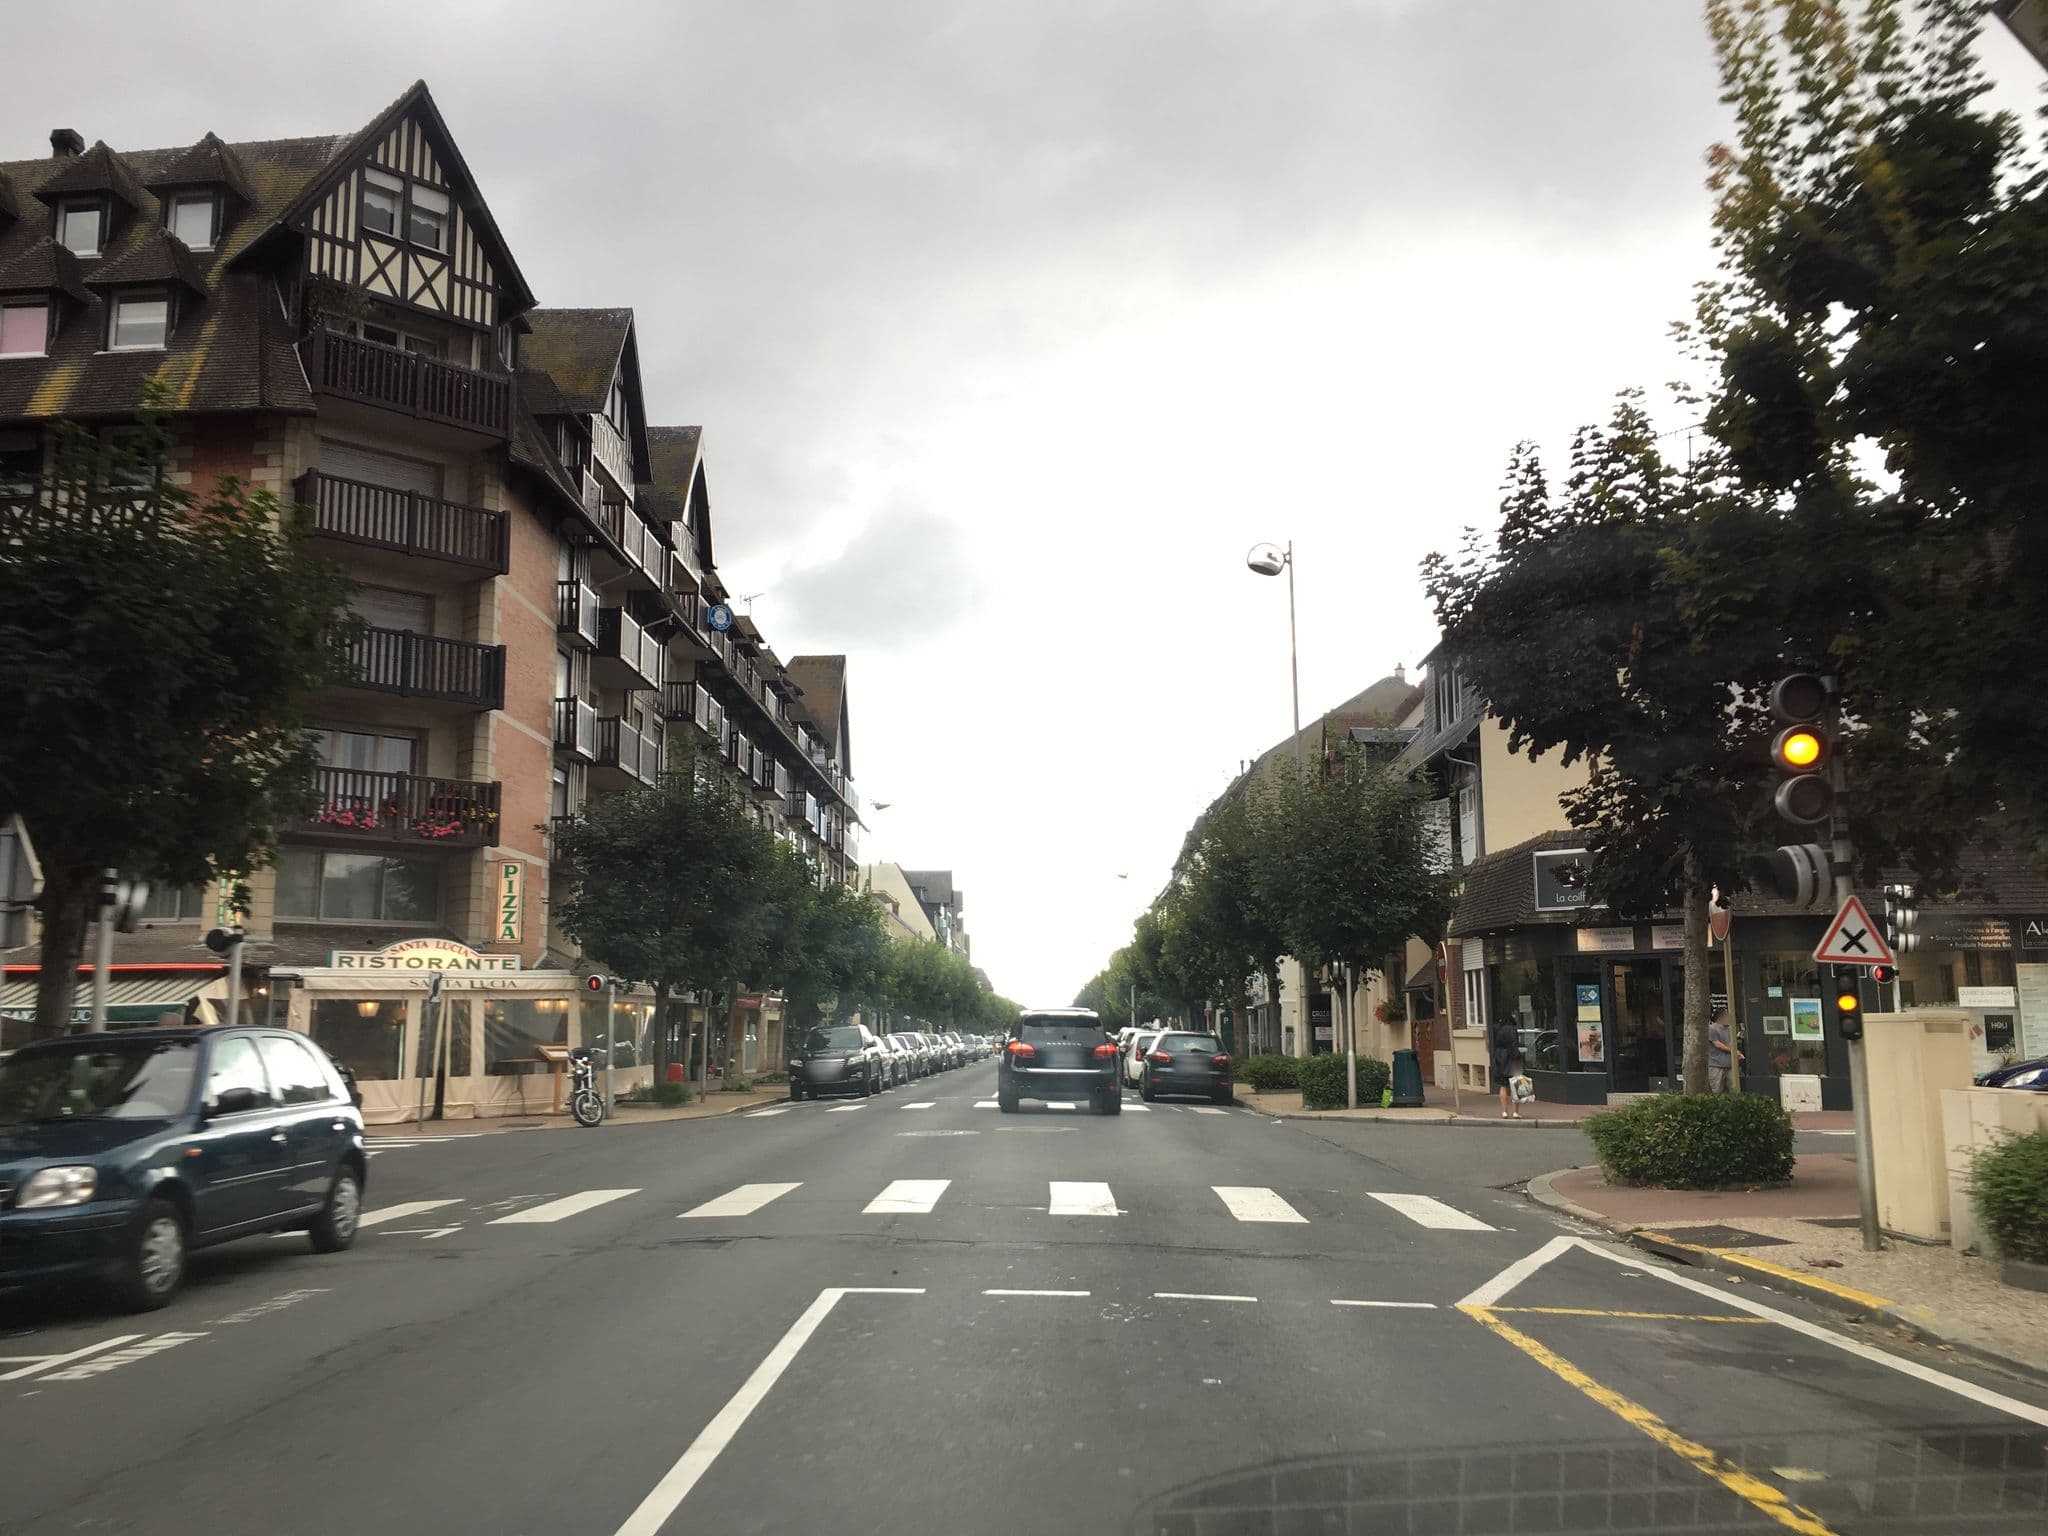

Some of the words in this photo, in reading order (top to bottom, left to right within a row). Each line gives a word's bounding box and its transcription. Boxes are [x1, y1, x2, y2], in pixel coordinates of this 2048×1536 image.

[502, 865, 518, 939] PIZZA
[1567, 890, 1587, 902] coiff
[391, 941, 429, 955] SANTA
[435, 940, 470, 958] LUCIA
[338, 955, 516, 970] RISTORANTE
[410, 980, 463, 988] SATA
[469, 980, 518, 989] LUCIA
